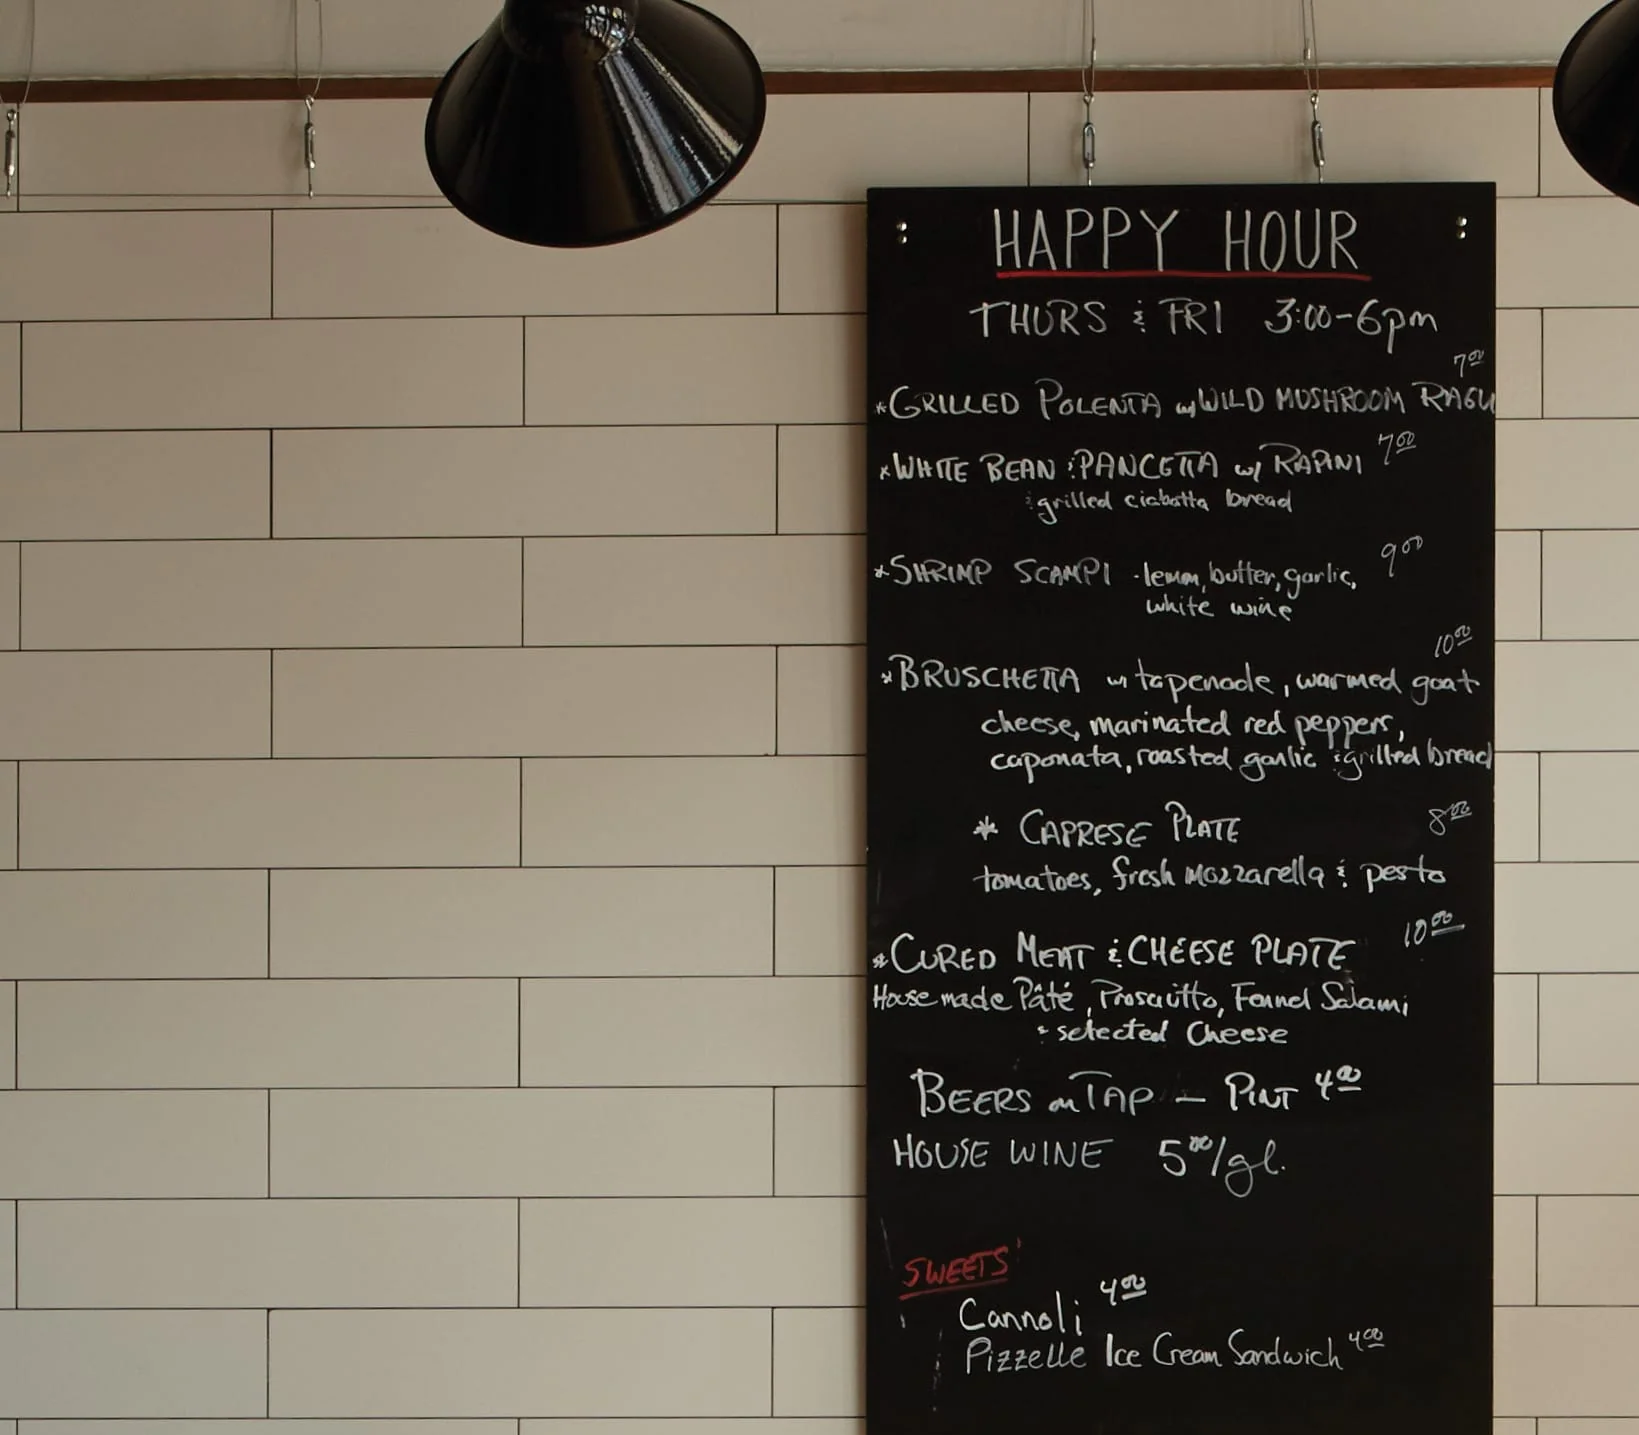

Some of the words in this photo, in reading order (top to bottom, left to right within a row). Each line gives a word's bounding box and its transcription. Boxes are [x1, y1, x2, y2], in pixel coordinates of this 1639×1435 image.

[995, 207, 1179, 272] HAPPY
[1226, 208, 1358, 271] HOUR
[969, 300, 1106, 337] THURS
[1159, 298, 1221, 334] FRI
[1264, 298, 1437, 354] 3:00-6pm
[889, 386, 1019, 419] GRILLED
[1036, 379, 1161, 420] POLENTA
[1276, 386, 1405, 413] MUSHROOM
[893, 452, 969, 482] WHITE
[979, 453, 1055, 483] BEAN
[1259, 443, 1361, 475] RAPINI
[1124, 488, 1209, 511] ciabatta
[1226, 488, 1292, 512] bread
[890, 555, 992, 585] SHRIMP
[1014, 557, 1110, 586] SCAMPI
[1147, 594, 1214, 617] white
[1230, 602, 1292, 621] wine
[888, 654, 1080, 693] BRUSCHETTA
[1296, 668, 1402, 694] warmed
[1412, 669, 1480, 705] goat
[1089, 705, 1231, 737] marinated
[1244, 710, 1286, 735] red
[1137, 744, 1232, 770] roasted
[1239, 745, 1316, 782] garlic
[1427, 738, 1492, 769] bread
[1020, 809, 1152, 848] CAPRESE
[1165, 801, 1241, 843] PLATE
[1112, 855, 1175, 891] fresh
[1360, 854, 1446, 893] pesto
[891, 933, 996, 973] CURED
[1017, 931, 1095, 970] MEAT
[1128, 935, 1234, 966] CHEESE
[1251, 933, 1356, 970] PLATE
[1057, 1018, 1169, 1042] selected
[1187, 1021, 1288, 1046] Cheese
[910, 1068, 1031, 1117] BEERS
[1069, 1071, 1154, 1116] TAP
[1225, 1072, 1299, 1111] PINT
[893, 1133, 989, 1169] HOUSE
[1011, 1139, 1113, 1168] WINE
[960, 1291, 1082, 1336] Cannoli
[967, 1337, 1086, 1374] Pizzelle
[1106, 1333, 1142, 1367] Ice
[1153, 1332, 1222, 1367] Cream
[1228, 1329, 1343, 1370] Sandwich
